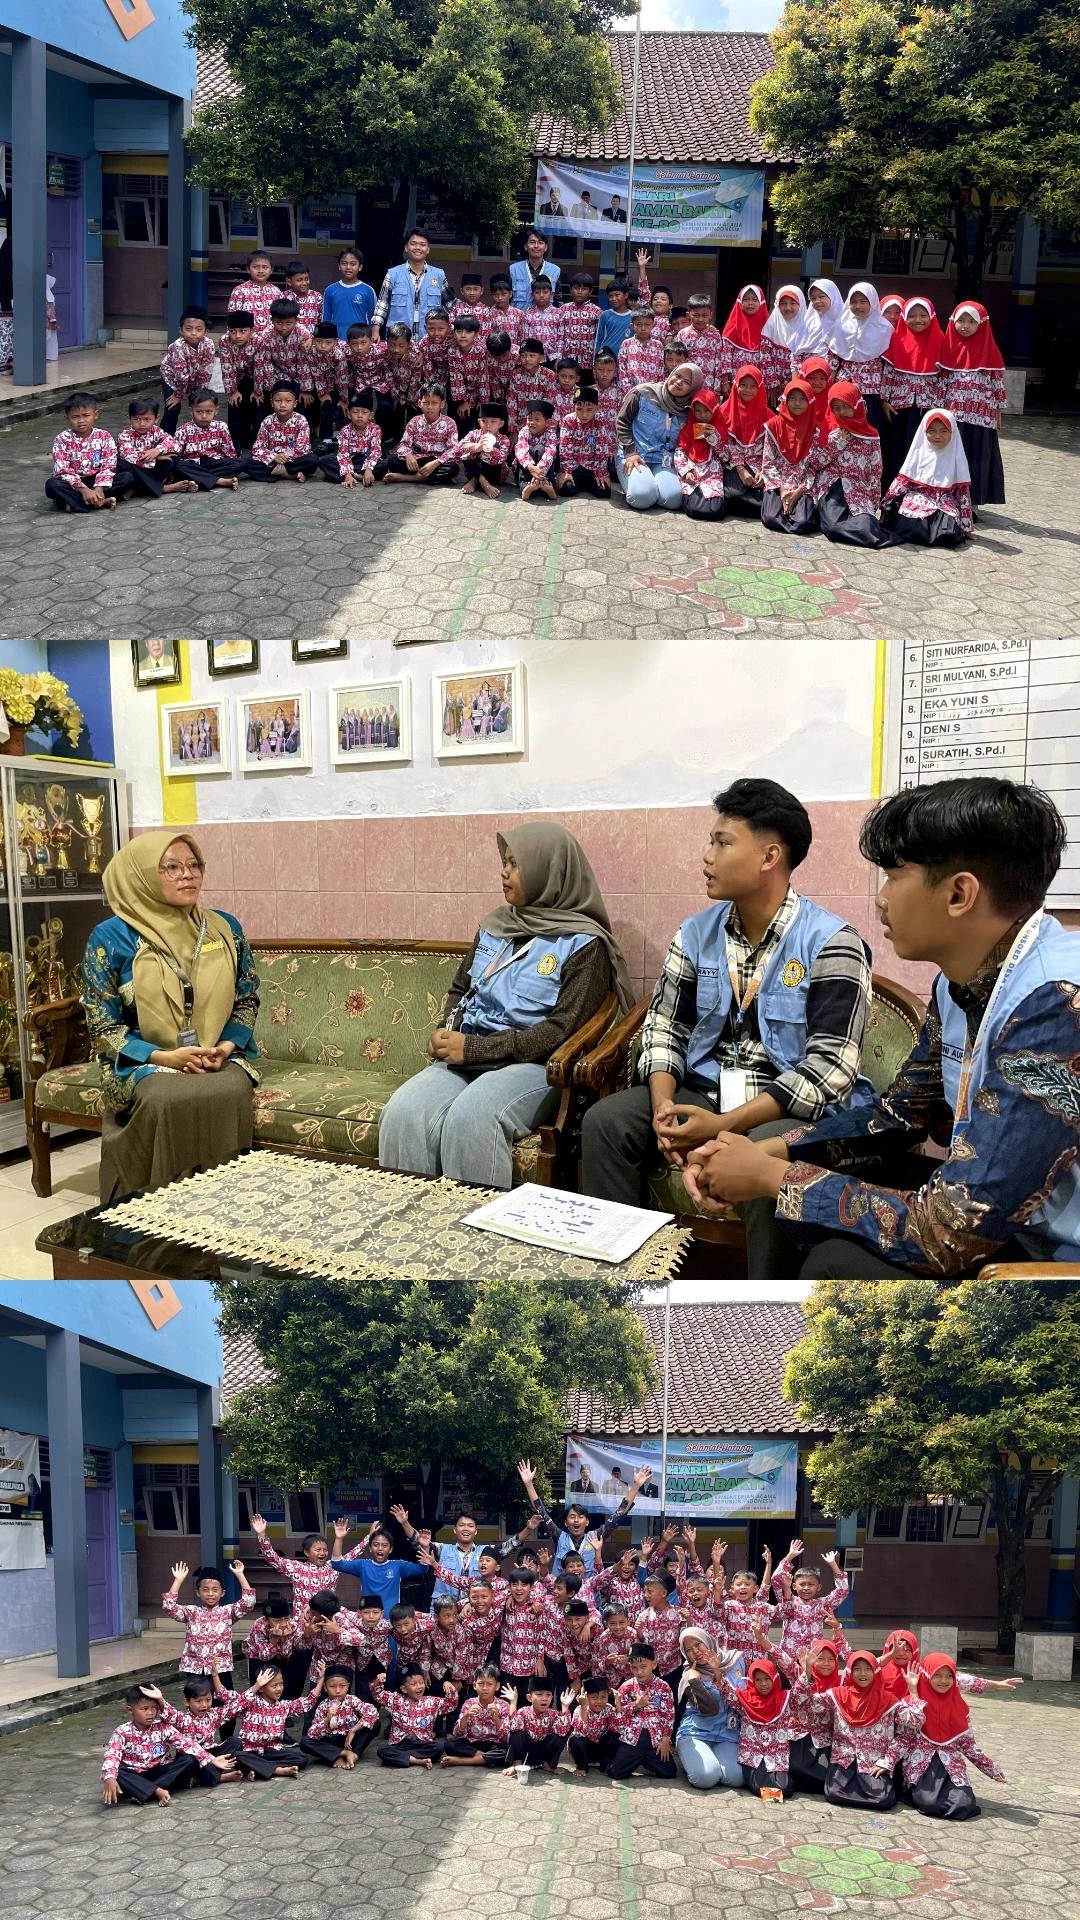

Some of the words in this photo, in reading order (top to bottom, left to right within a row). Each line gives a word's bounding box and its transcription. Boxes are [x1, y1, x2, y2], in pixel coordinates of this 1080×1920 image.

[634, 191, 676, 202] HARI
[926, 648, 942, 658] SITI
[944, 642, 999, 656] NURFARIDA,
[1002, 640, 1028, 649] S.Pd.I
[909, 654, 917, 662] 6.
[925, 674, 941, 684] SRI
[943, 670, 987, 682] MULYANI,
[990, 666, 1017, 677] S.Pd.I
[924, 699, 947, 709] EKA
[951, 696, 978, 706] YUNI
[981, 695, 988, 703] S
[924, 725, 950, 734] DENI
[953, 724, 960, 732] S
[923, 749, 971, 759] SURATIH,
[975, 746, 1006, 756] S.Pd.I
[1013, 930, 1032, 960] UNSOED
[667, 1465, 708, 1475] HARI
[666, 1478, 714, 1491] AMAL
[715, 1478, 765, 1491] BAKTI
